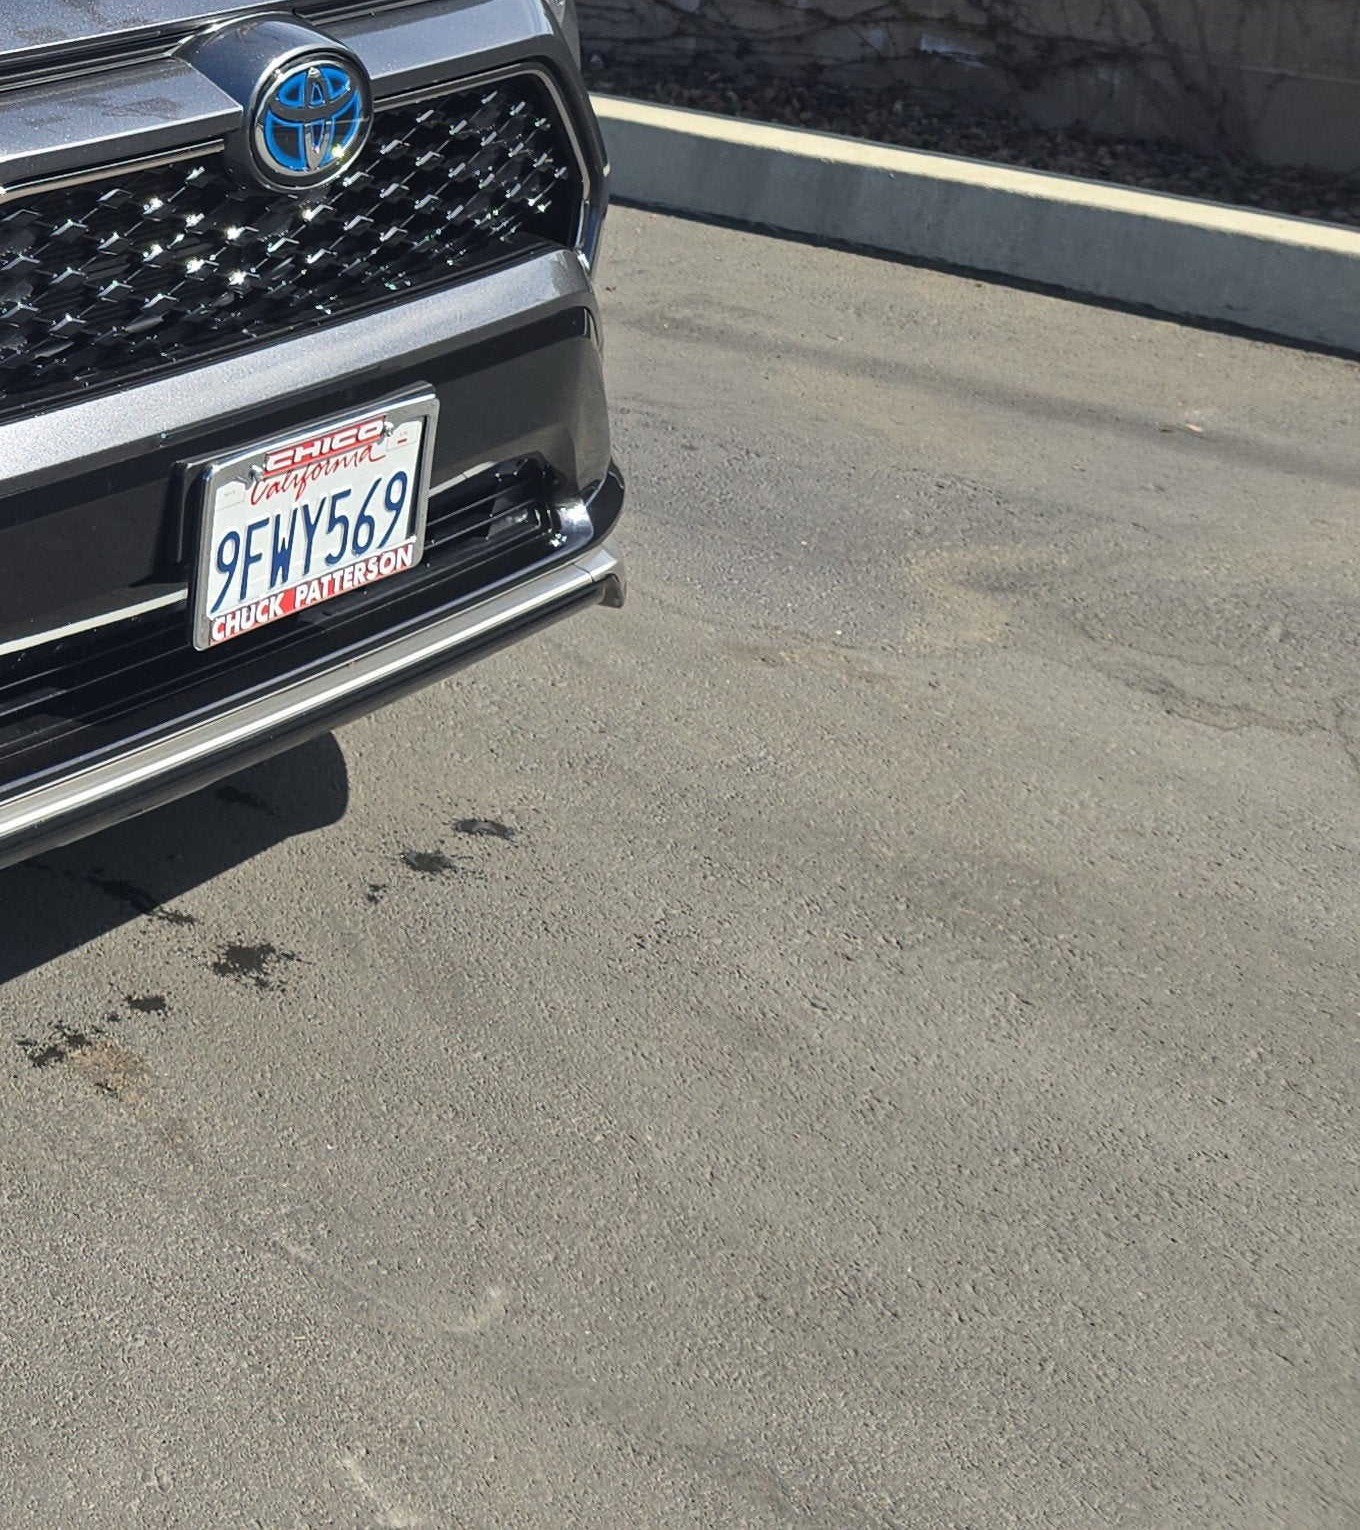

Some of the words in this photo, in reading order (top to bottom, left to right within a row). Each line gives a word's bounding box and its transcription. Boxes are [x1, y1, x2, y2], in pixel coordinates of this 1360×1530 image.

[251, 444, 385, 506] California
[266, 420, 384, 472] CHICO
[212, 471, 408, 612] 9FWY569
[213, 594, 283, 641] CHUCK
[295, 545, 413, 608] PATTERSON
